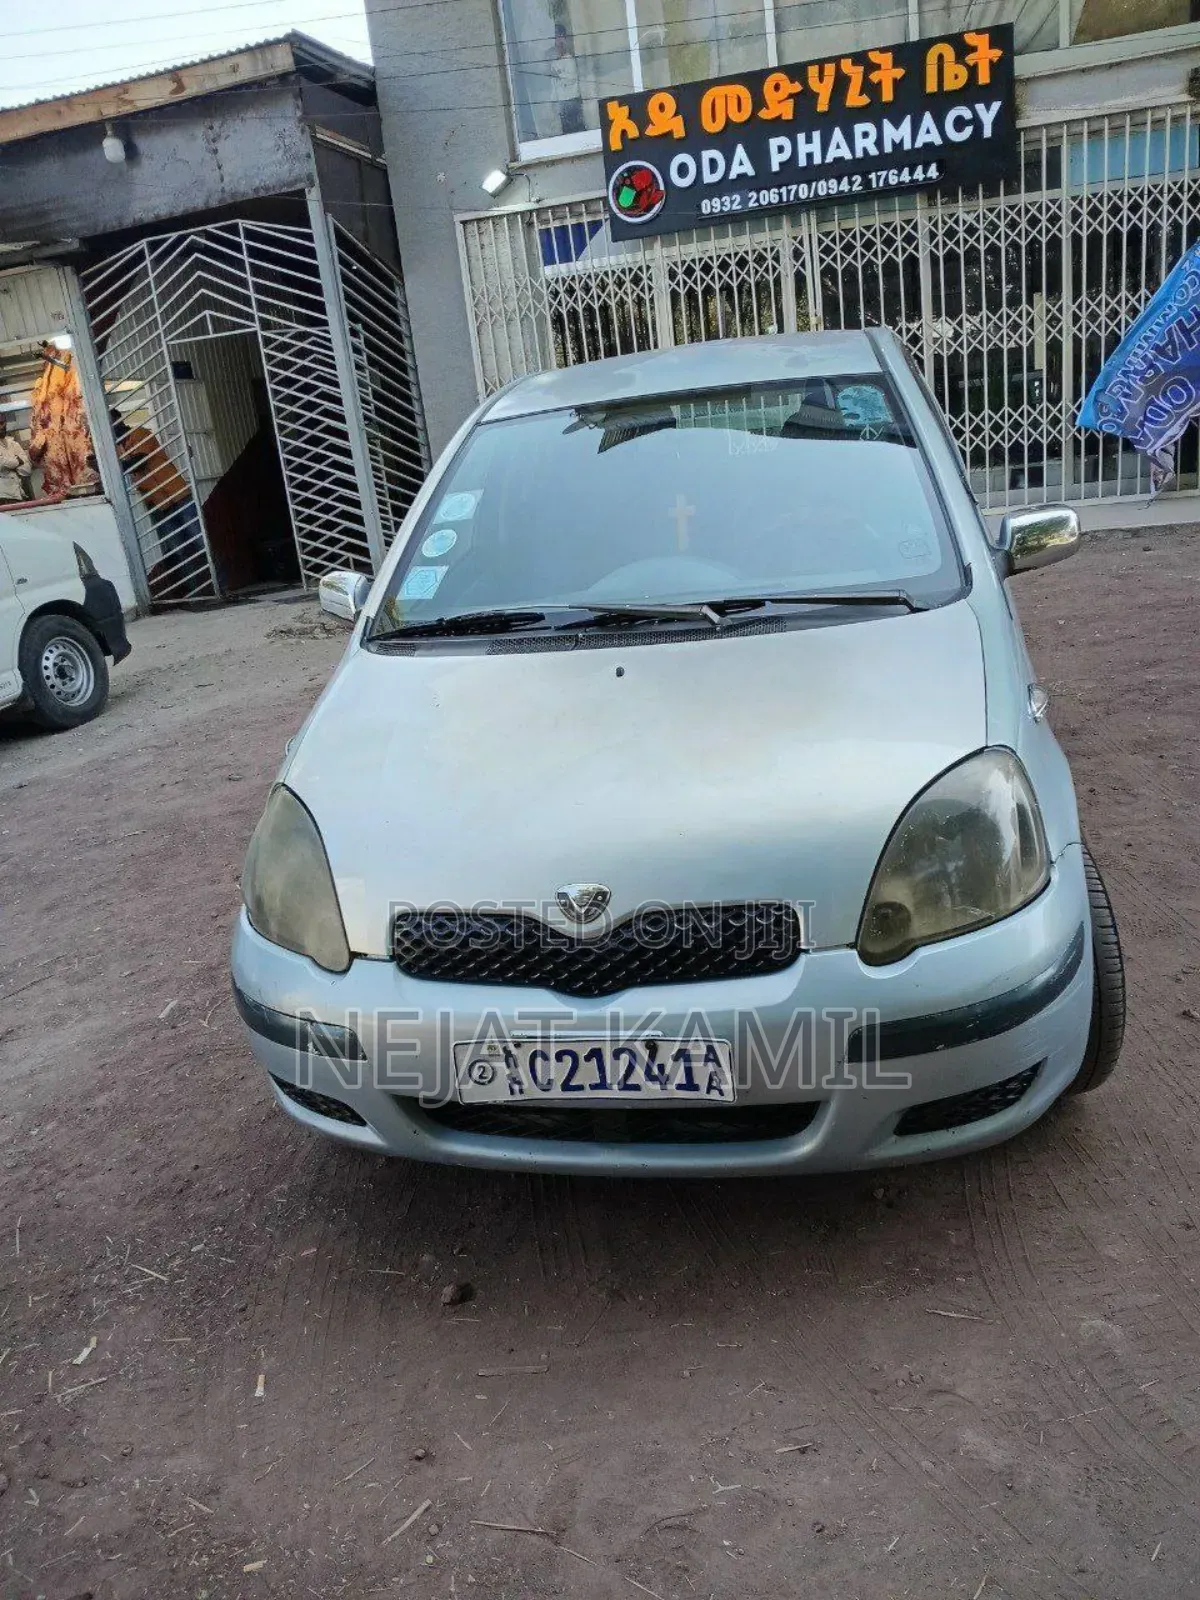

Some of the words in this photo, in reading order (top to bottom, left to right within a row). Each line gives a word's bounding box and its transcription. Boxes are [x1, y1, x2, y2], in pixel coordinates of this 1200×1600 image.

[606, 91, 686, 151] ኦዳ
[925, 31, 1003, 94] ቤት
[669, 148, 755, 188] ODA
[769, 100, 1002, 172] PHARMACY
[701, 194, 742, 215] 0932
[868, 162, 940, 188] 176444
[528, 1047, 700, 1092] C21241
